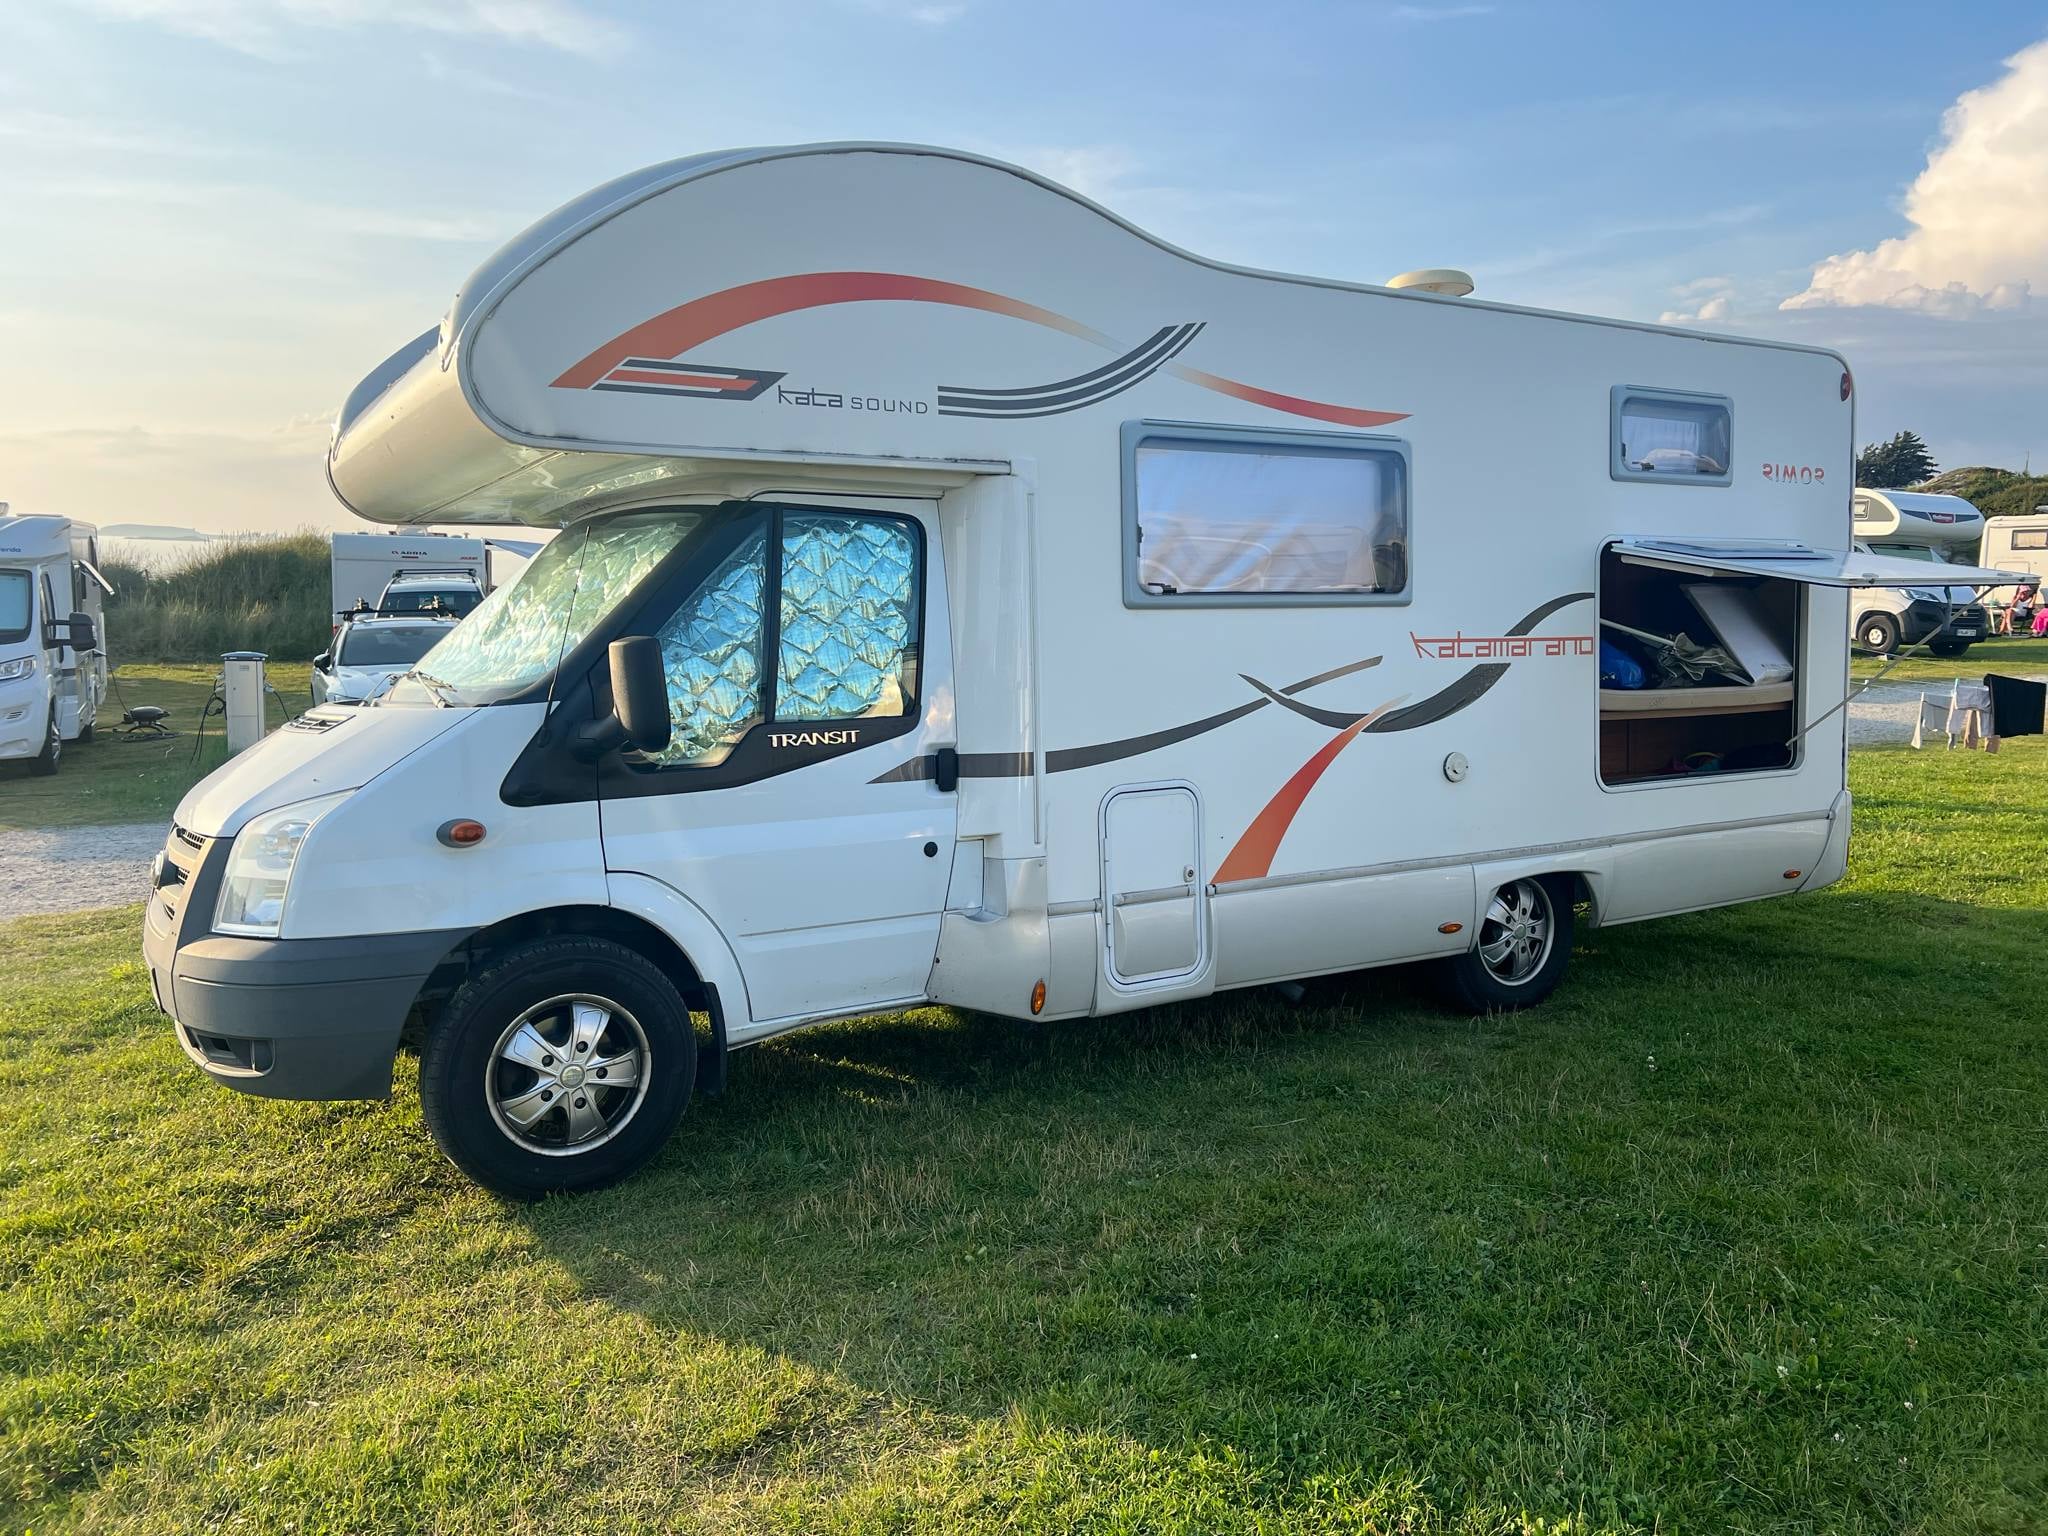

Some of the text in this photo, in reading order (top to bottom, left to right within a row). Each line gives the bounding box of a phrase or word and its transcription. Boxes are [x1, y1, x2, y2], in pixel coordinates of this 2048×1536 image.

[777, 384, 929, 415] kata SOUND
[1761, 463, 1826, 485] RIMOR
[767, 729, 861, 748] TRANSIT
